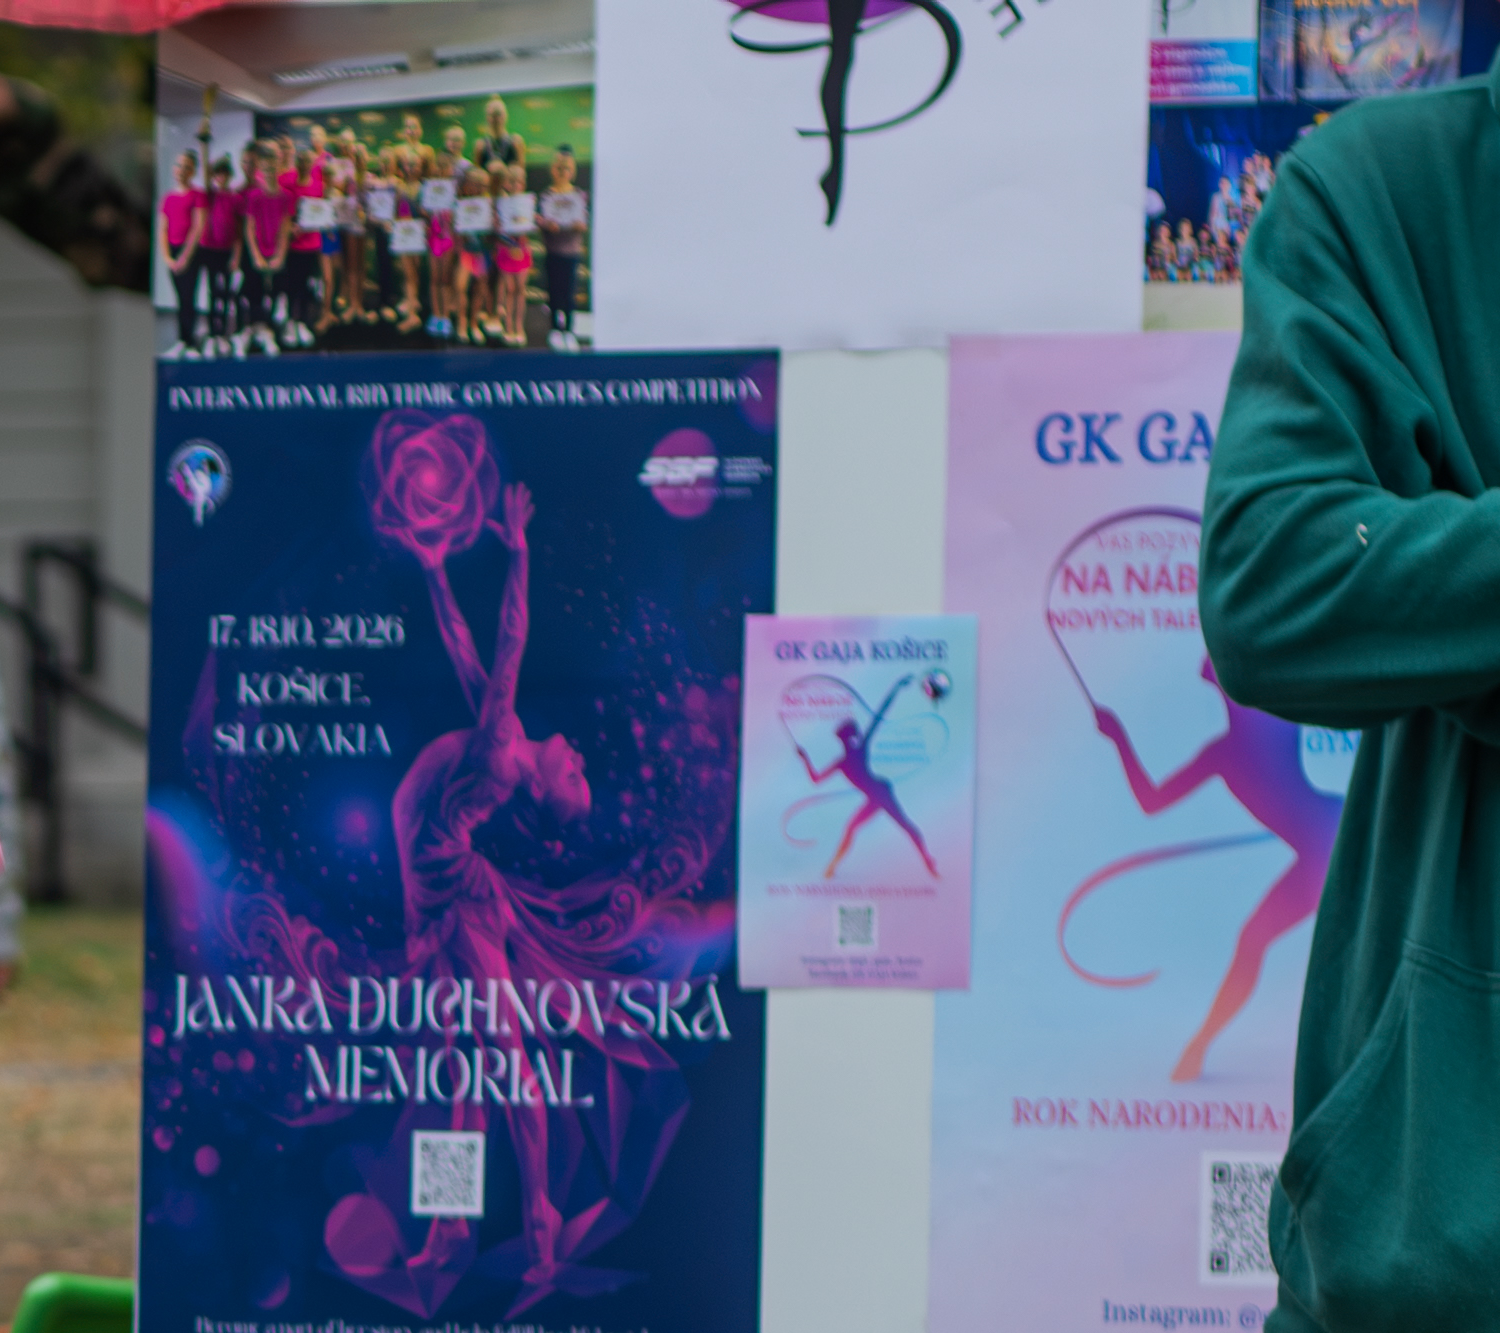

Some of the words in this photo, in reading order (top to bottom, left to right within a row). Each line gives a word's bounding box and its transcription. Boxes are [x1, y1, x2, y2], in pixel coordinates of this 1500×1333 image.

[168, 383, 343, 410] INTERNATIONAL
[345, 380, 459, 408] RHYTHMIC
[462, 379, 602, 407] GYMNASTICS
[604, 375, 763, 405] COMPETITION
[1034, 411, 1123, 465] GK
[1062, 563, 1113, 595] NA
[320, 613, 406, 649] 2026
[775, 640, 807, 661] GK
[812, 640, 865, 664] GAJA
[871, 634, 949, 662] KOŠICE
[213, 722, 392, 757] SLOVAKIA
[173, 973, 334, 1039] JANKA
[348, 971, 733, 1042] DUCHNOVSKÁ
[304, 1044, 596, 1107] MEMORIAL
[1011, 1095, 1080, 1129] ROK
[1087, 1097, 1288, 1132] NARODENIA:
[1102, 1299, 1232, 1331] Instagram:
